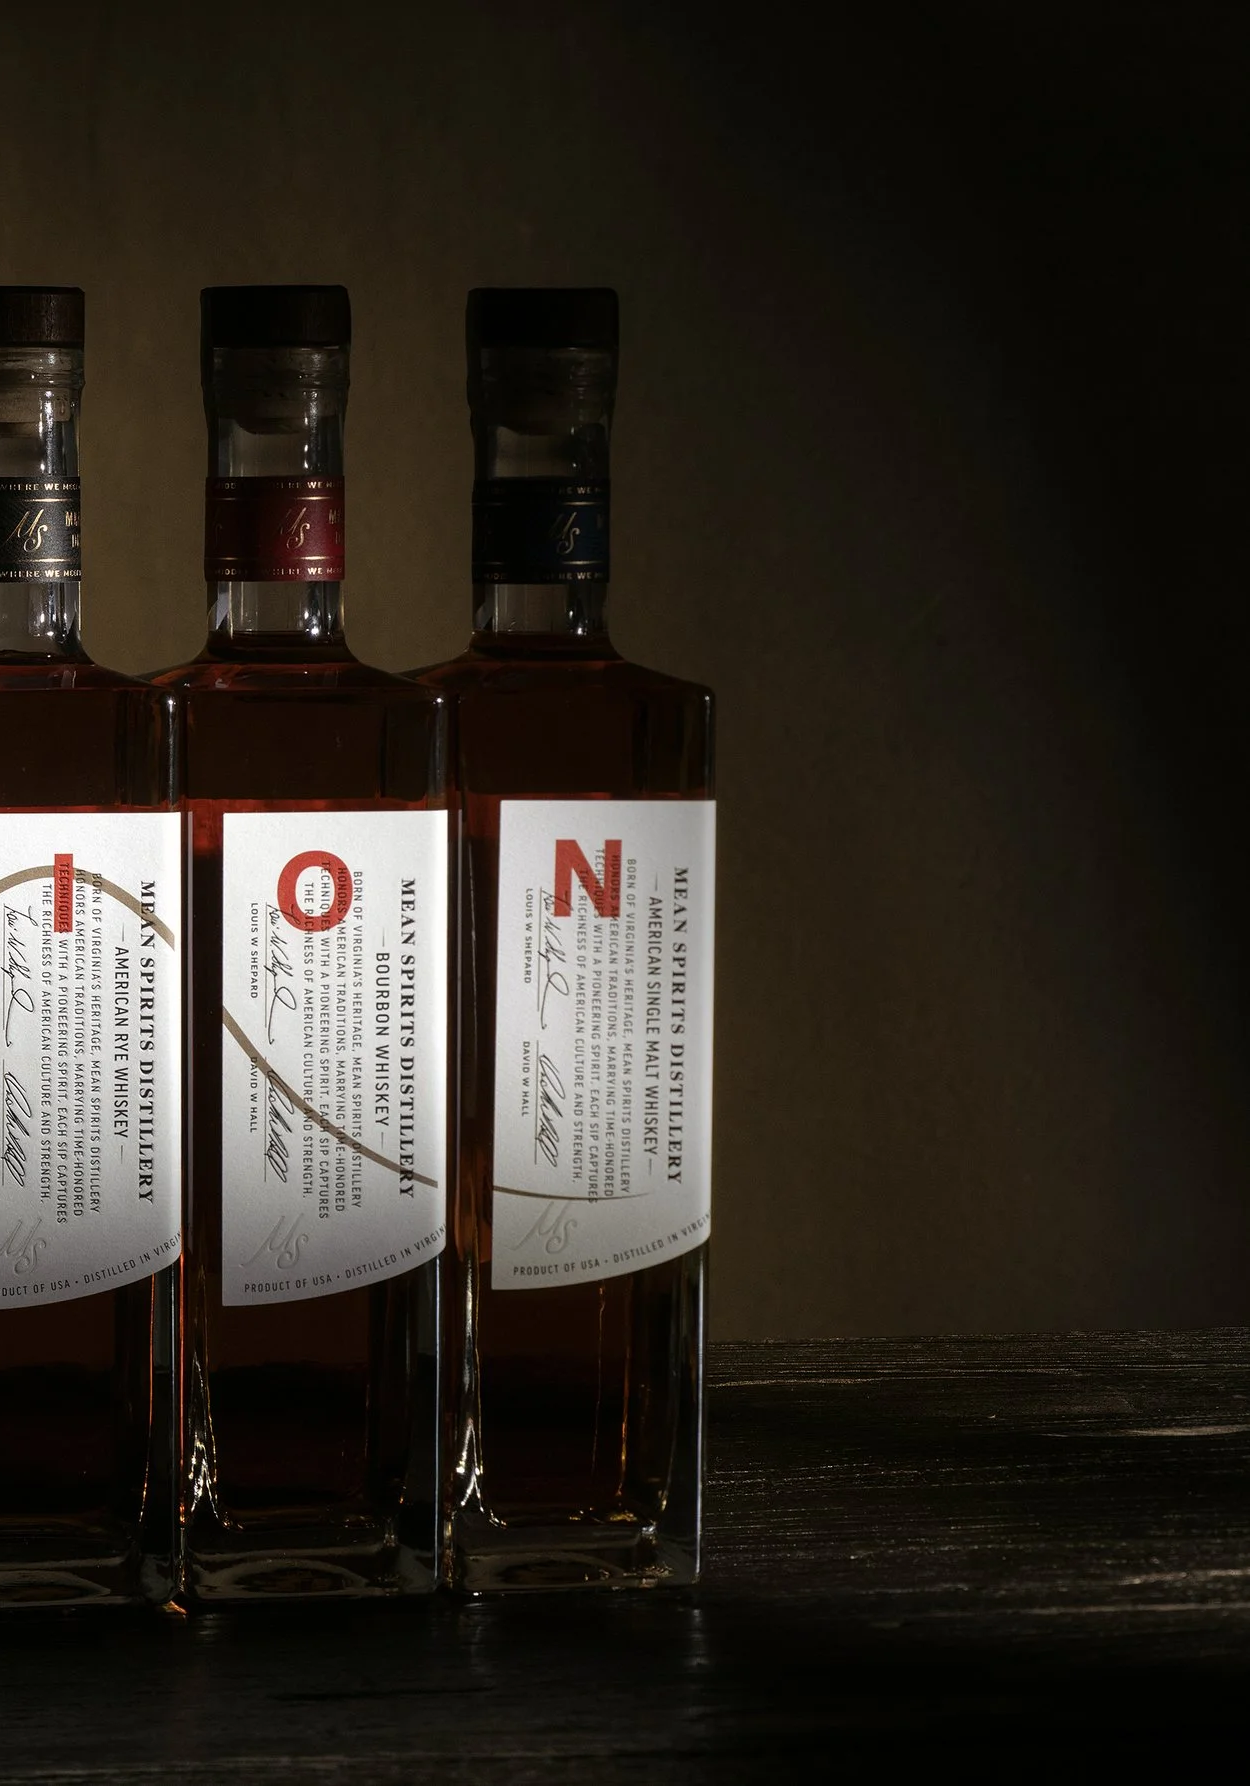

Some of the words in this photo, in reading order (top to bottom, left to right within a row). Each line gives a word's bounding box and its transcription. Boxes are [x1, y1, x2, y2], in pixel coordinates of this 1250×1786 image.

[54, 853, 75, 932] I
[74, 867, 86, 916] HONORS
[90, 872, 103, 904] BORN
[278, 850, 353, 932] O
[525, 887, 534, 919] LOUIS
[555, 840, 622, 916] N
[673, 867, 688, 933] MEAN
[91, 908, 102, 923] OF
[140, 880, 156, 949] MEAN
[250, 902, 259, 933] LOUIS
[250, 936, 259, 947] W
[401, 879, 416, 946] MEAN
[525, 921, 533, 933] W
[647, 896, 663, 976] AMERICAN
[74, 919, 86, 981] AMERICAN
[91, 927, 102, 991] VIRGINIA'S
[250, 950, 259, 999] SHEPARD
[523, 935, 533, 984] SHEPARD
[114, 946, 129, 1027] AMERICAN
[139, 957, 155, 1051] SPIRITS
[375, 952, 391, 1036] BOURBON
[400, 954, 415, 1048] SPIRITS
[645, 981, 661, 1035] SINGLE
[671, 942, 686, 1035] SPIRITS
[73, 984, 86, 1059] TRADITIONS,
[90, 995, 102, 1056] HERITAGE,
[114, 1033, 129, 1062] RYE
[90, 1060, 101, 1093] MEAN
[249, 1055, 260, 1089] DAVID
[375, 1044, 390, 1127] WHISKEY
[521, 1076, 530, 1088] W
[522, 1040, 531, 1074] DAVID
[645, 1040, 660, 1080] MALT
[73, 1063, 85, 1125] MARRYING
[89, 1097, 101, 1144] SPIRITS
[113, 1067, 129, 1139] WHISKEY
[249, 1092, 258, 1103] W
[249, 1106, 258, 1133] HALL
[521, 1090, 530, 1117] HALL
[643, 1085, 659, 1155] WHISKEY
[667, 1043, 684, 1184] DISTILLERY
[138, 1059, 154, 1203] DISTILLERY
[399, 1056, 415, 1198] DISTILLERY
[73, 1128, 85, 1217] TIME-HONORED
[89, 1146, 101, 1213] DISTILLERY
[33, 1283, 46, 1293] OF
[50, 1279, 71, 1291] USA
[83, 1259, 137, 1284] DISTILLED
[139, 1252, 151, 1265] IN
[244, 1281, 290, 1293] PRODUCT
[295, 1278, 308, 1288] OF
[312, 1275, 333, 1286] USA
[345, 1254, 398, 1279] DISTILLED
[400, 1248, 412, 1259] IN
[513, 1264, 559, 1276] PRODUCT
[564, 1261, 576, 1272] OF
[580, 1260, 601, 1270] USA
[613, 1239, 665, 1263] DISTILLED
[667, 1232, 679, 1245] IN
